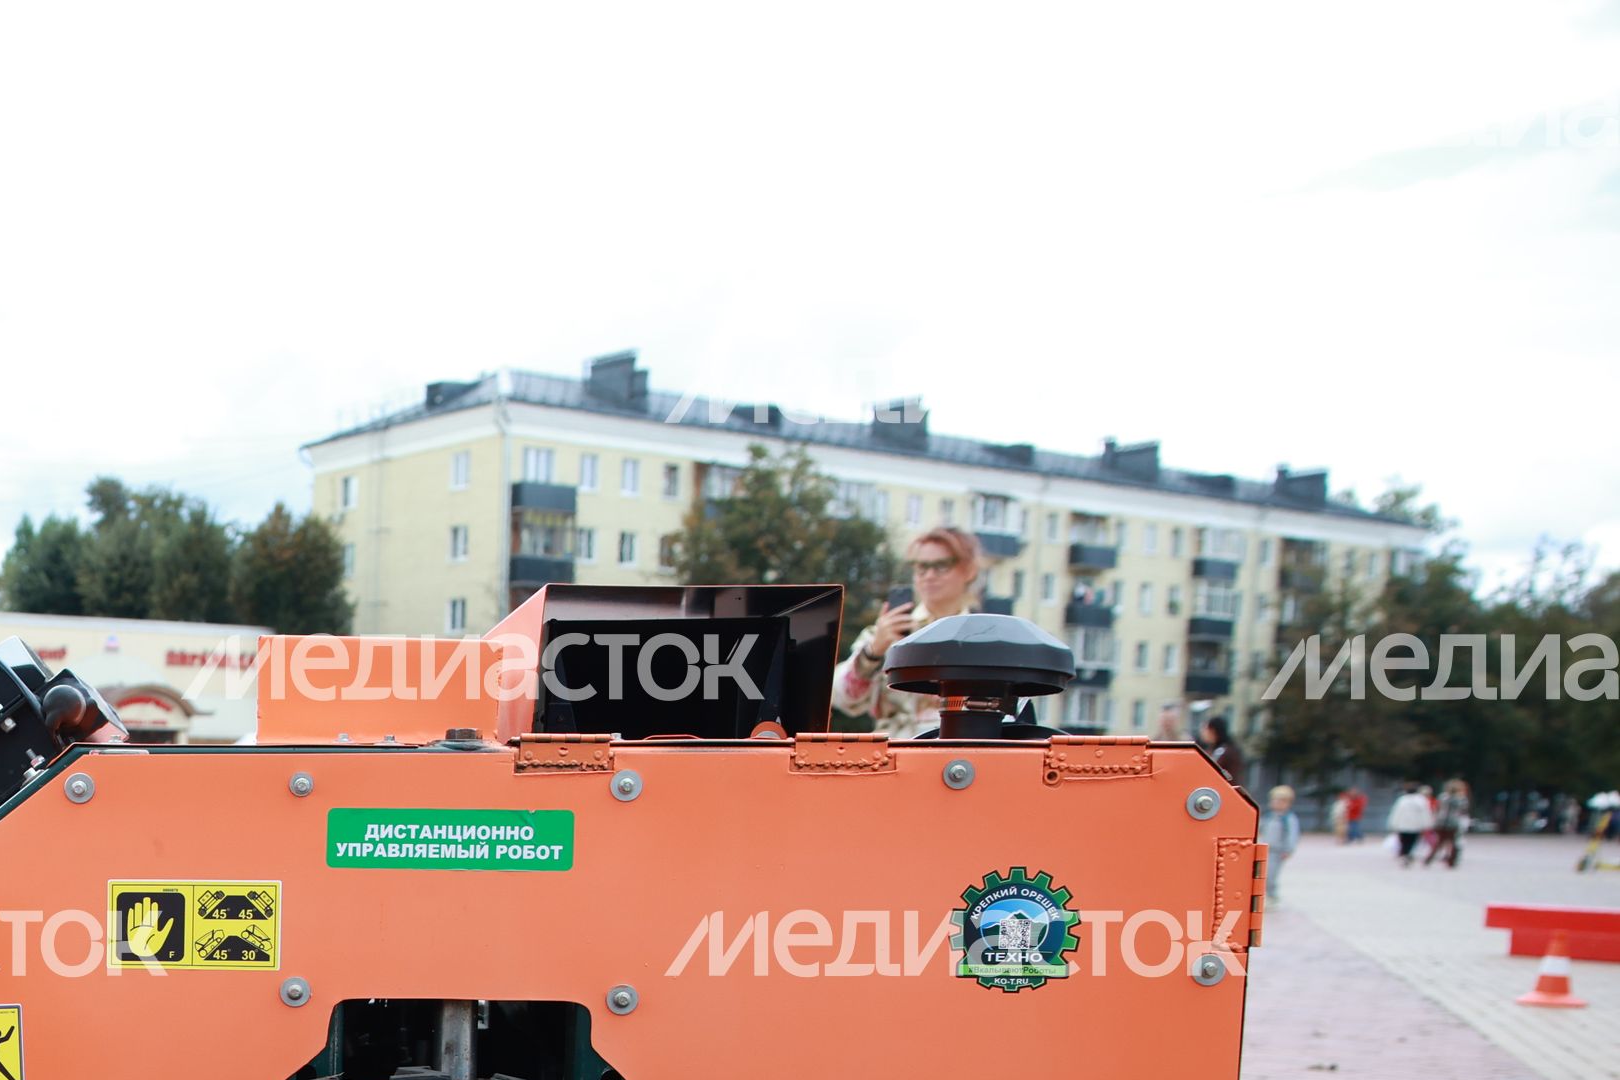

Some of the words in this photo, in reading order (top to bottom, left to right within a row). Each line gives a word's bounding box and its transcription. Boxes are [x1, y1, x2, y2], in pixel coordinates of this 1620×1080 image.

[364, 824, 535, 842] ДИСТАНЦИОННО
[336, 842, 489, 859] УПРАВЛЯЕМЫЙ
[495, 845, 563, 860] РОБОТ
[970, 886, 1018, 920] КРЕПКИЙ
[1020, 887, 1061, 921] ОРЕШЕК
[984, 952, 1044, 963] ТЕХНО
